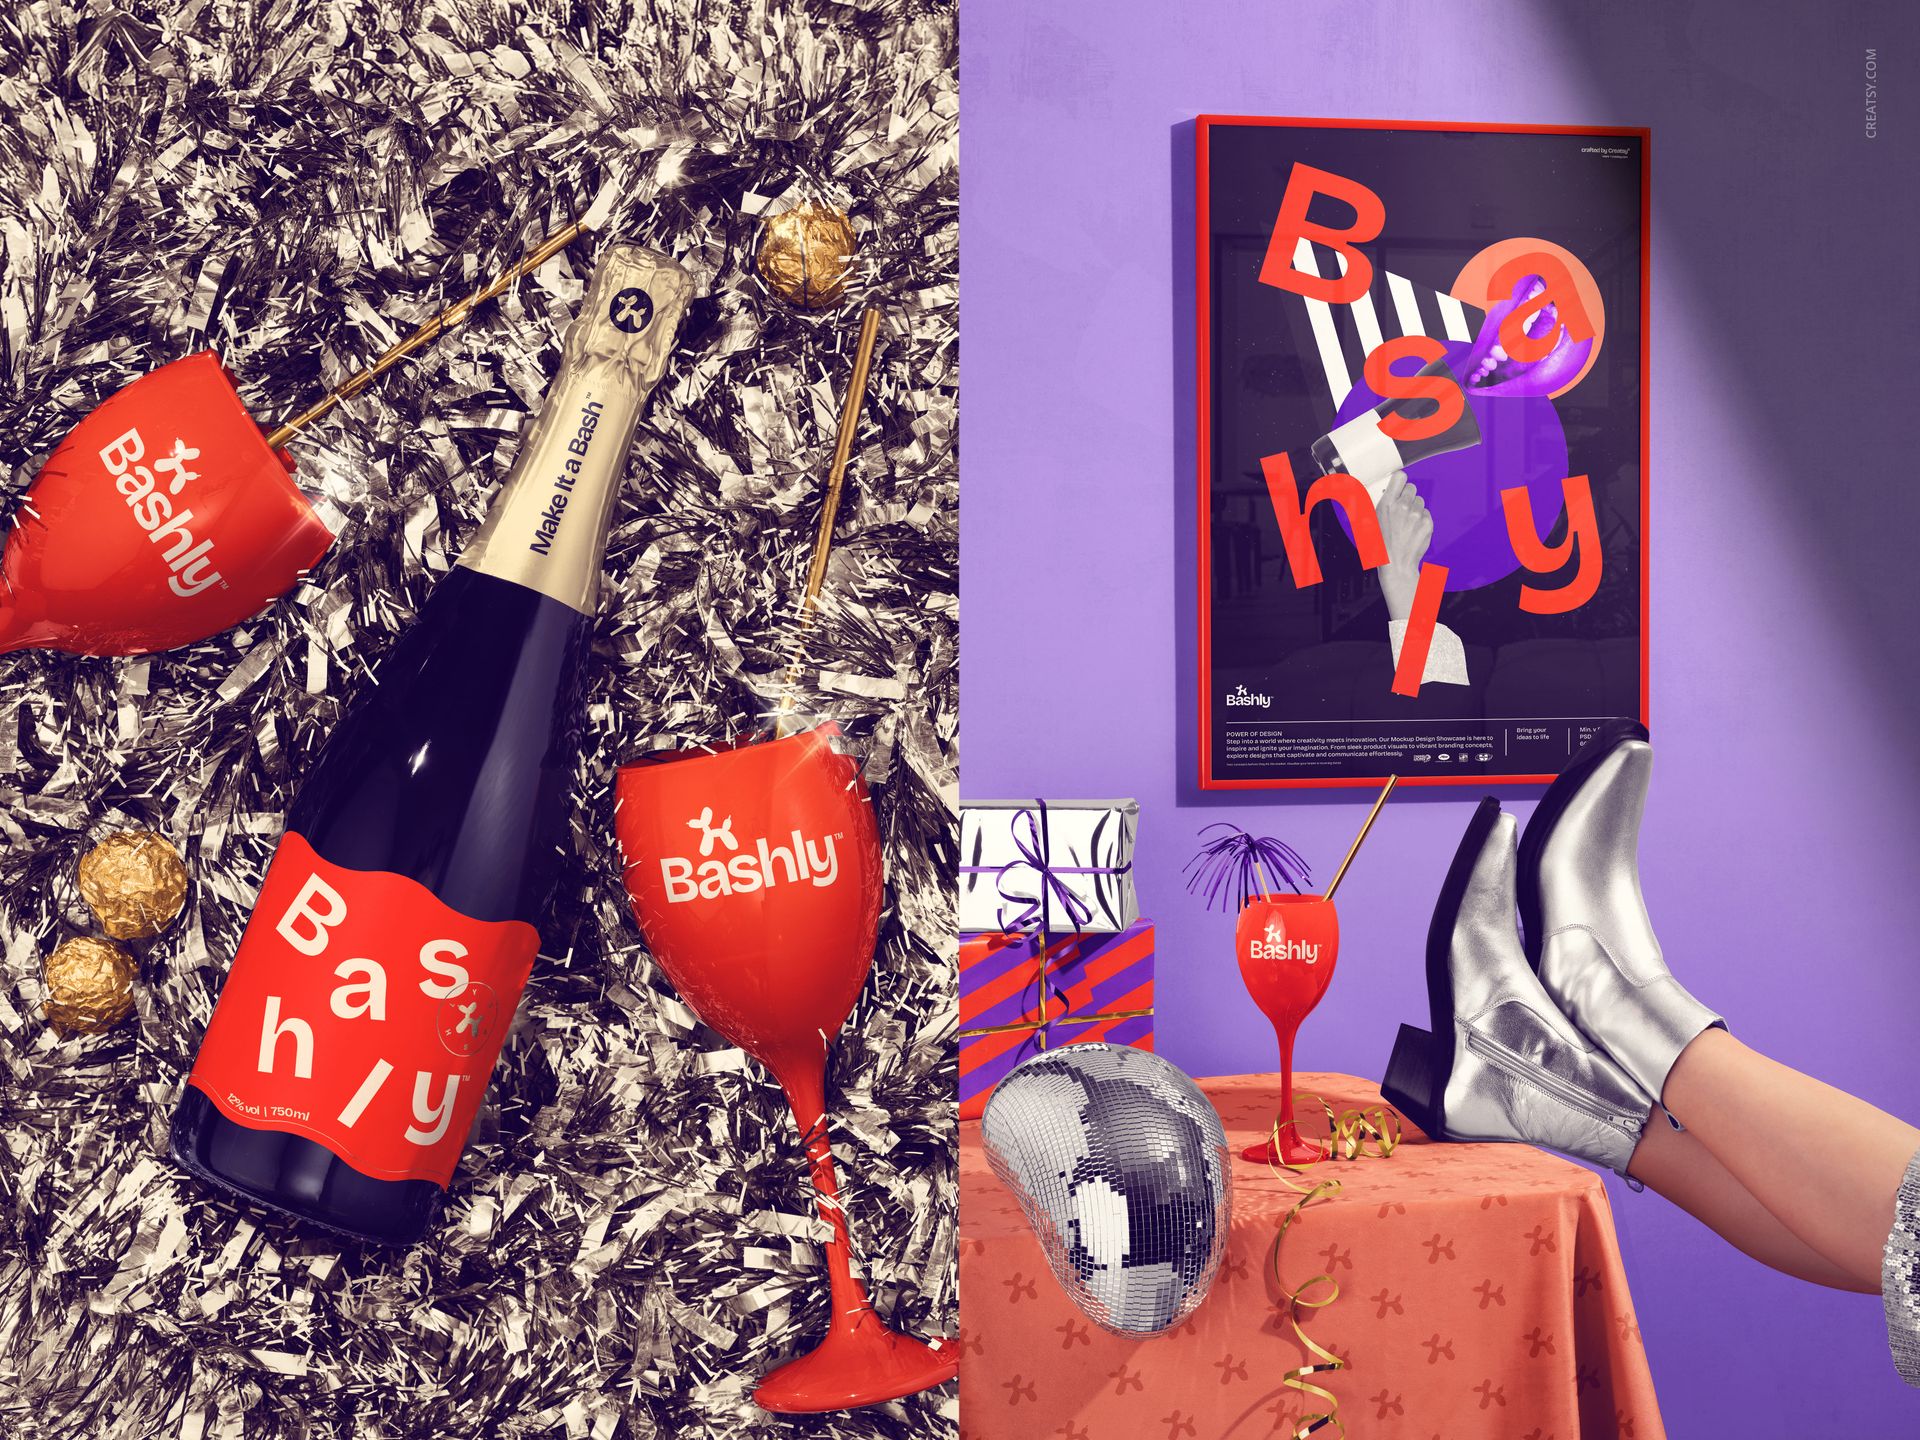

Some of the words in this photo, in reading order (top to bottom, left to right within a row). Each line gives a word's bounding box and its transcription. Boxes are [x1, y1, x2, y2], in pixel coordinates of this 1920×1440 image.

[568, 401, 604, 452] Bash
[565, 458, 582, 477] a
[554, 473, 576, 494] It
[529, 493, 568, 556] Make
[1226, 745, 1246, 753] inspire
[270, 1106, 310, 1121] 750ml
